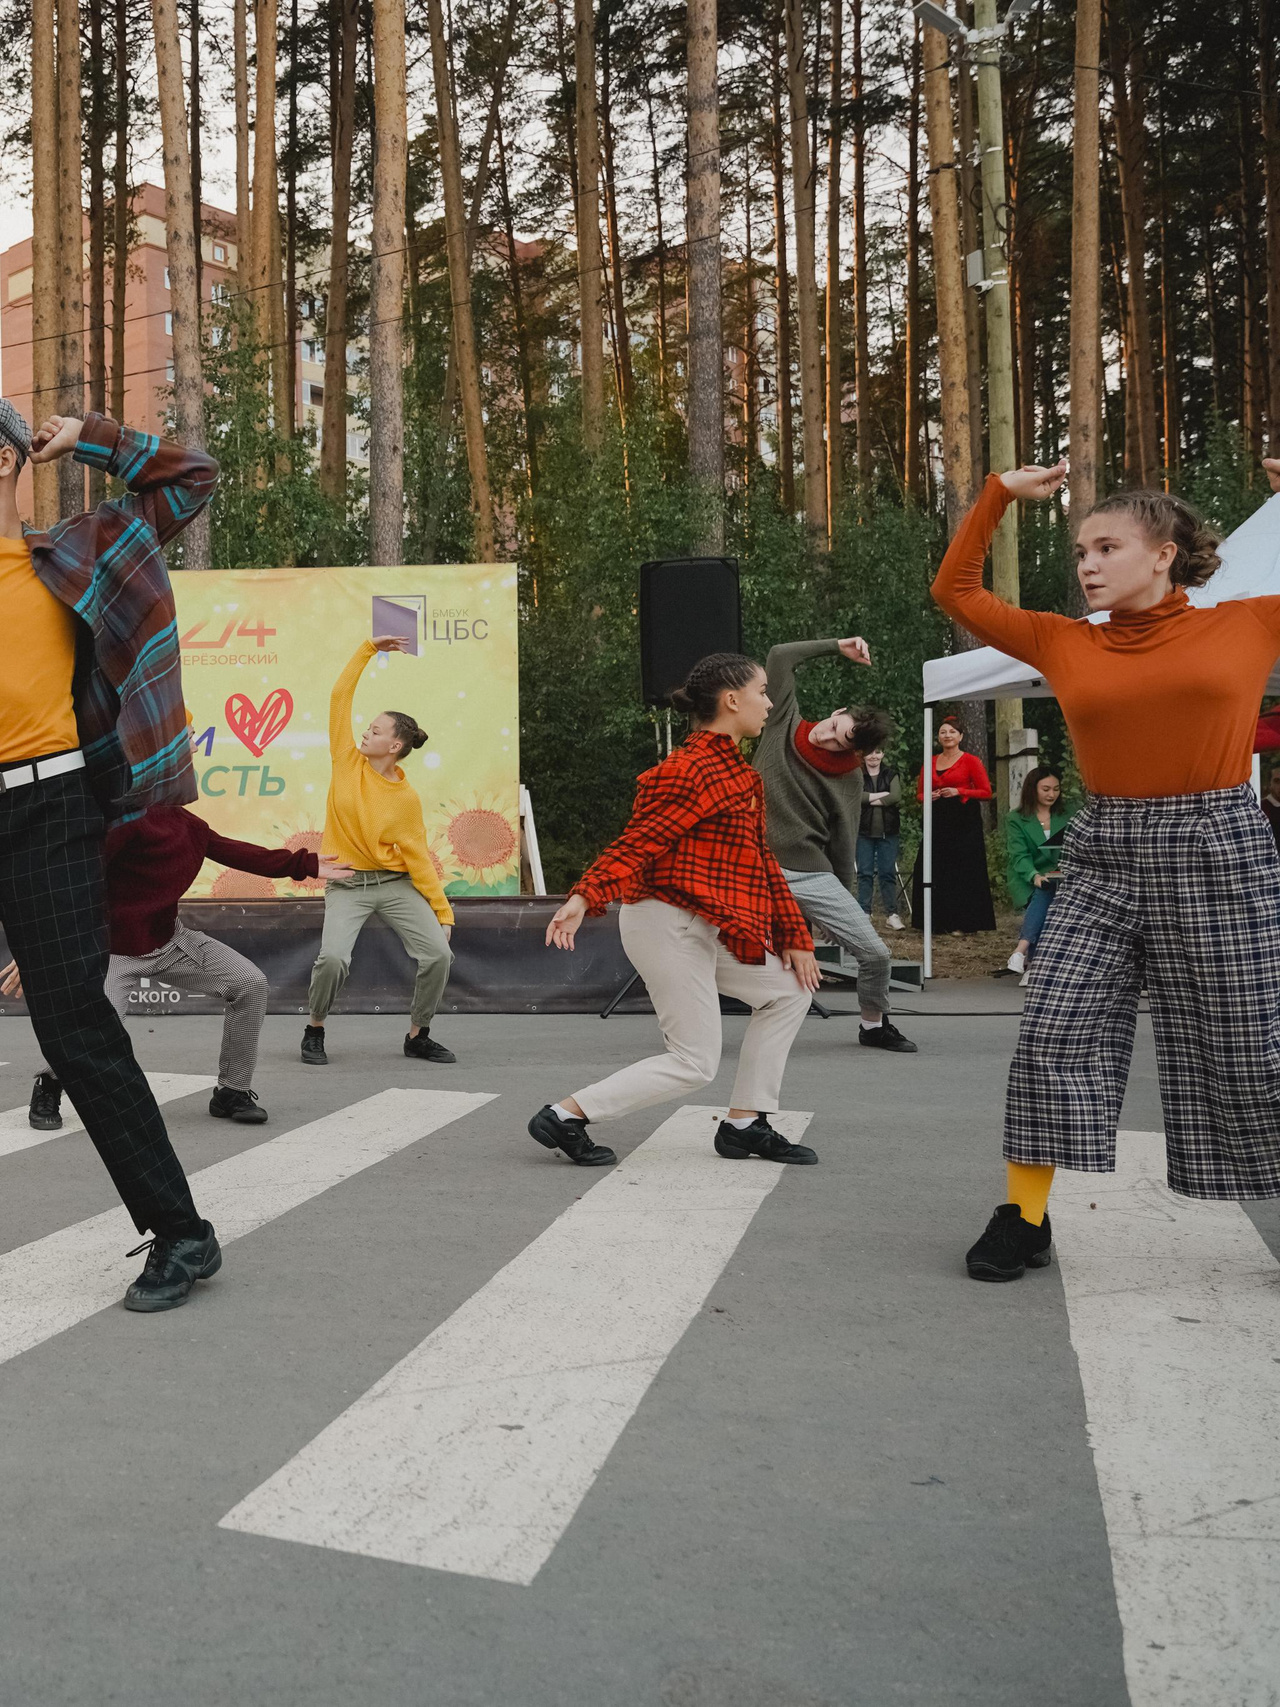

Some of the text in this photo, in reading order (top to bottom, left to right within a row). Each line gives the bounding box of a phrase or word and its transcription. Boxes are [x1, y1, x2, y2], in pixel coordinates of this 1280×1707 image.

[433, 619, 488, 645] ЦБС
[181, 651, 278, 666] ЕРЁЗОВСКИЙ
[194, 765, 286, 797] СТЬ
[128, 990, 181, 1003] СКОГО
